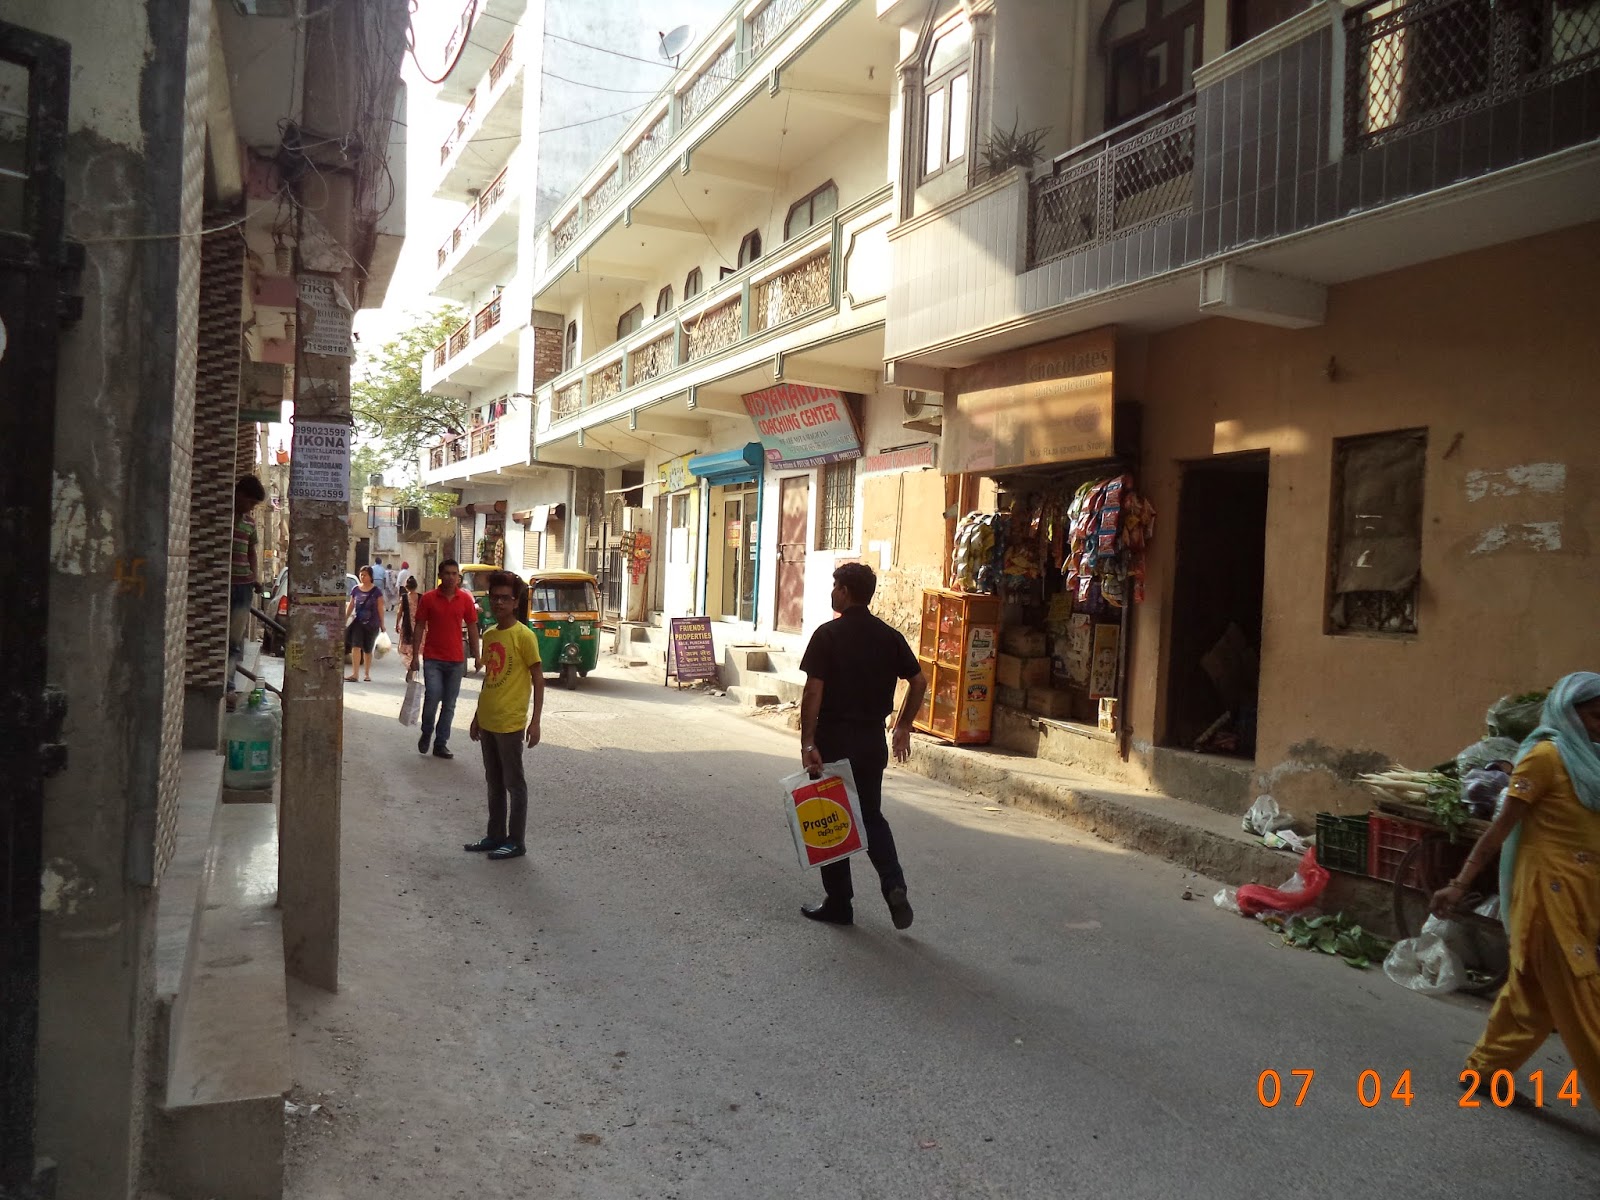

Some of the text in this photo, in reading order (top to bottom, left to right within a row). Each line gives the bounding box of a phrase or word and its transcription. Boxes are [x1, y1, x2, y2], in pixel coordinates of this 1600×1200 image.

[1028, 350, 1108, 382] Chocolates
[757, 402, 841, 436] COACHING CENTER
[675, 632, 712, 640] PROPERTIES
[802, 811, 840, 832] Pragati
